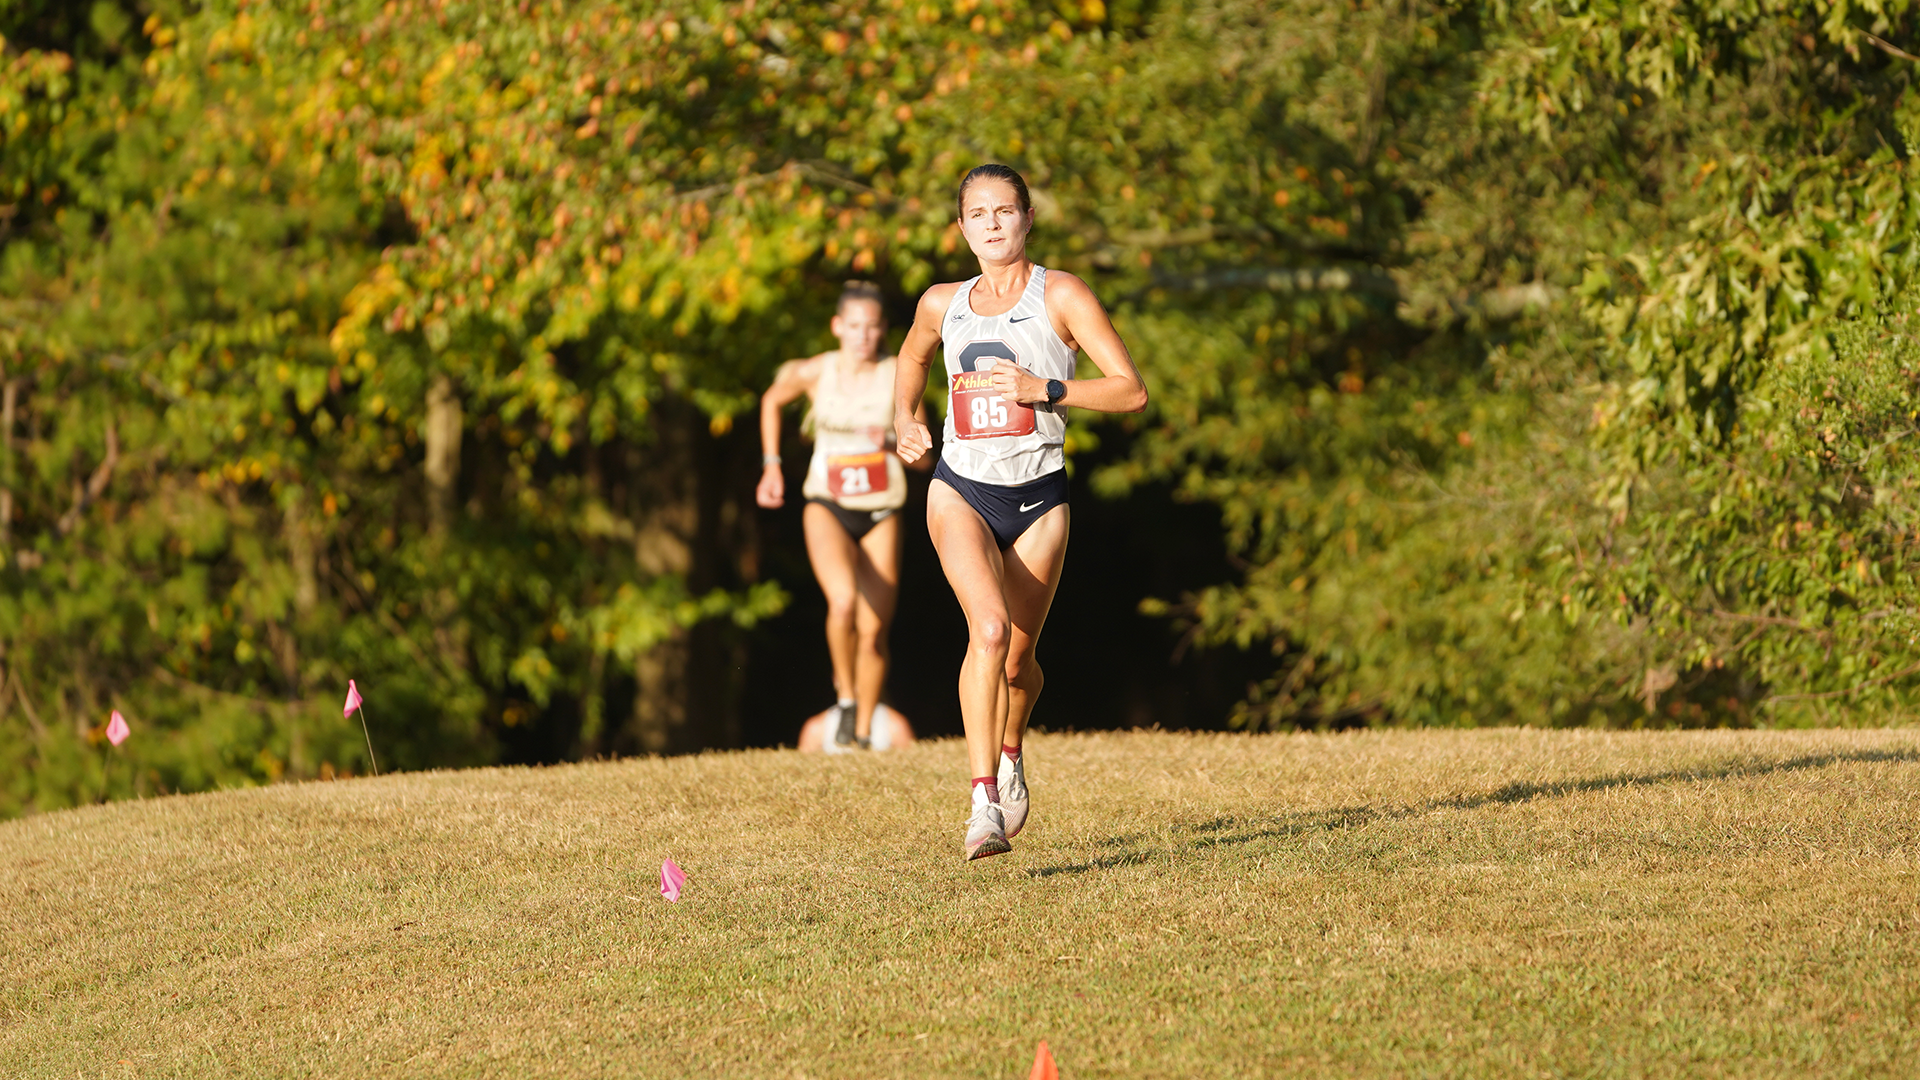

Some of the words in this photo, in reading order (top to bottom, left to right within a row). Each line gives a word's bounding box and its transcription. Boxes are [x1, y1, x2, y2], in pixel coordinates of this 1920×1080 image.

[953, 374, 995, 391] Athlet
[971, 396, 1008, 429] 85
[841, 467, 870, 495] 21
